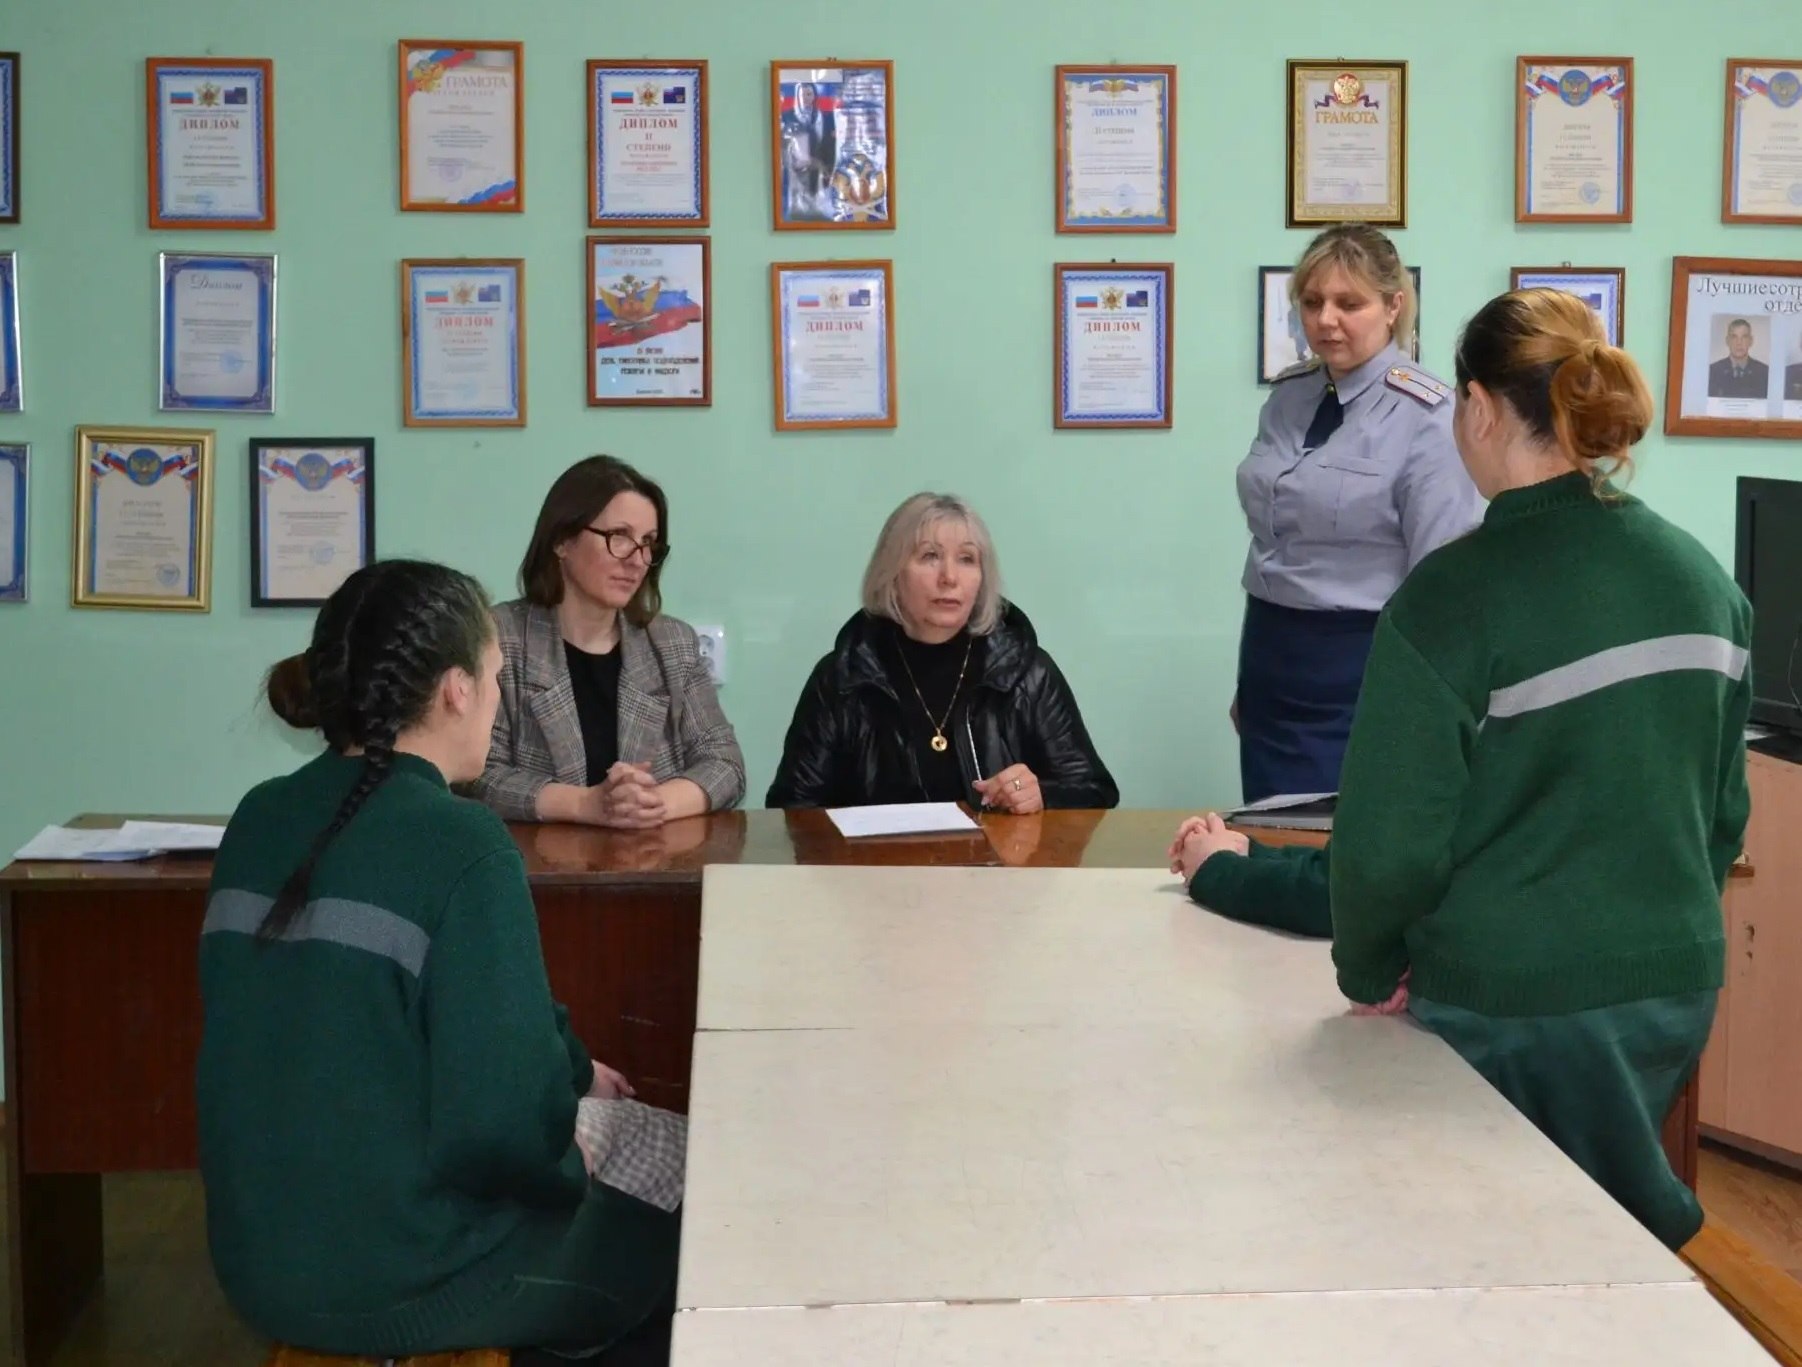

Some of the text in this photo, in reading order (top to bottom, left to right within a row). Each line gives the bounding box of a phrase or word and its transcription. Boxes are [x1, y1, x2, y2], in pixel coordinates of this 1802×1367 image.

[1315, 110, 1378, 124] ГРАМОТА
[619, 118, 678, 130] ДИПЛОМ
[1697, 277, 1767, 297] Лучшие
[806, 321, 864, 333] ДИПЛОМ
[1085, 321, 1141, 333] ДИПЛОМ
